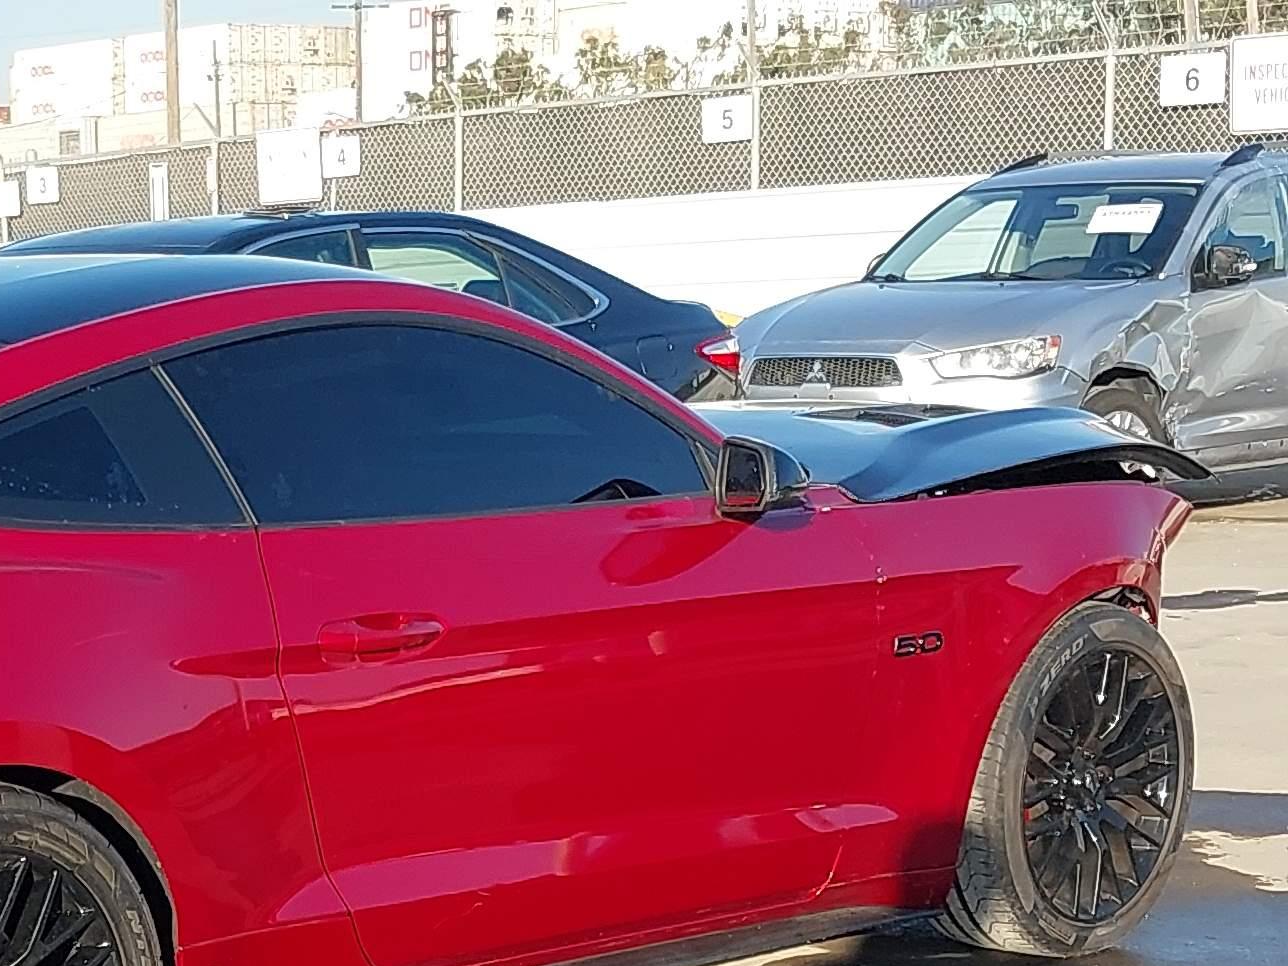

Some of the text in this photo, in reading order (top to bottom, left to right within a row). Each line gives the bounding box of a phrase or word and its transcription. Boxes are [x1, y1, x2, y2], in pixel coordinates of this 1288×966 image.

[1185, 67, 1200, 92] 6
[722, 109, 733, 130] 5
[337, 148, 346, 165] 4
[39, 176, 47, 194] 3
